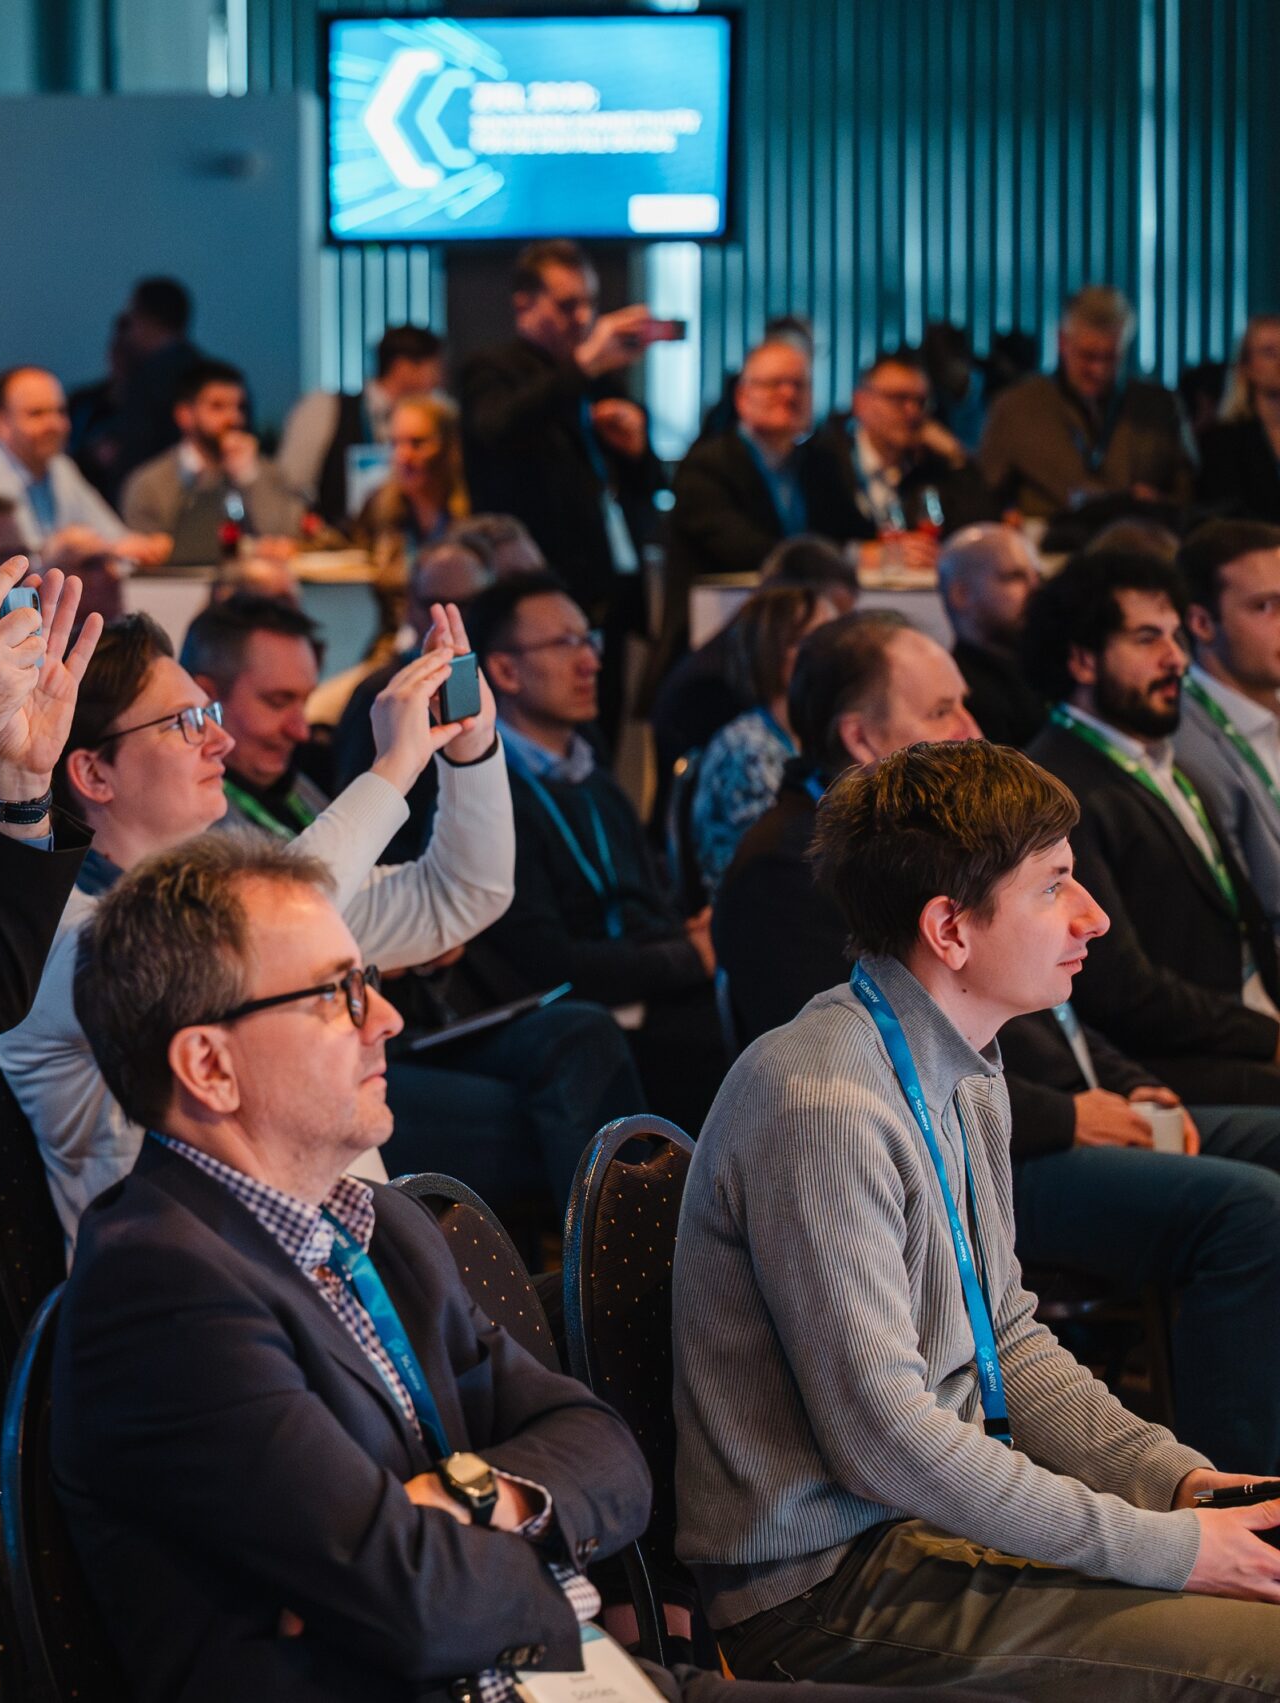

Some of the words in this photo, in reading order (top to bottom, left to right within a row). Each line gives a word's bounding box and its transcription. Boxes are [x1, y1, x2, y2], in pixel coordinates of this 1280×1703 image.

[857, 978, 880, 1003] 5G.NRW
[915, 1098, 930, 1131] 5G.NRW
[956, 1229, 968, 1261] 5G.NRW
[985, 1360, 998, 1392] 5G.NRW
